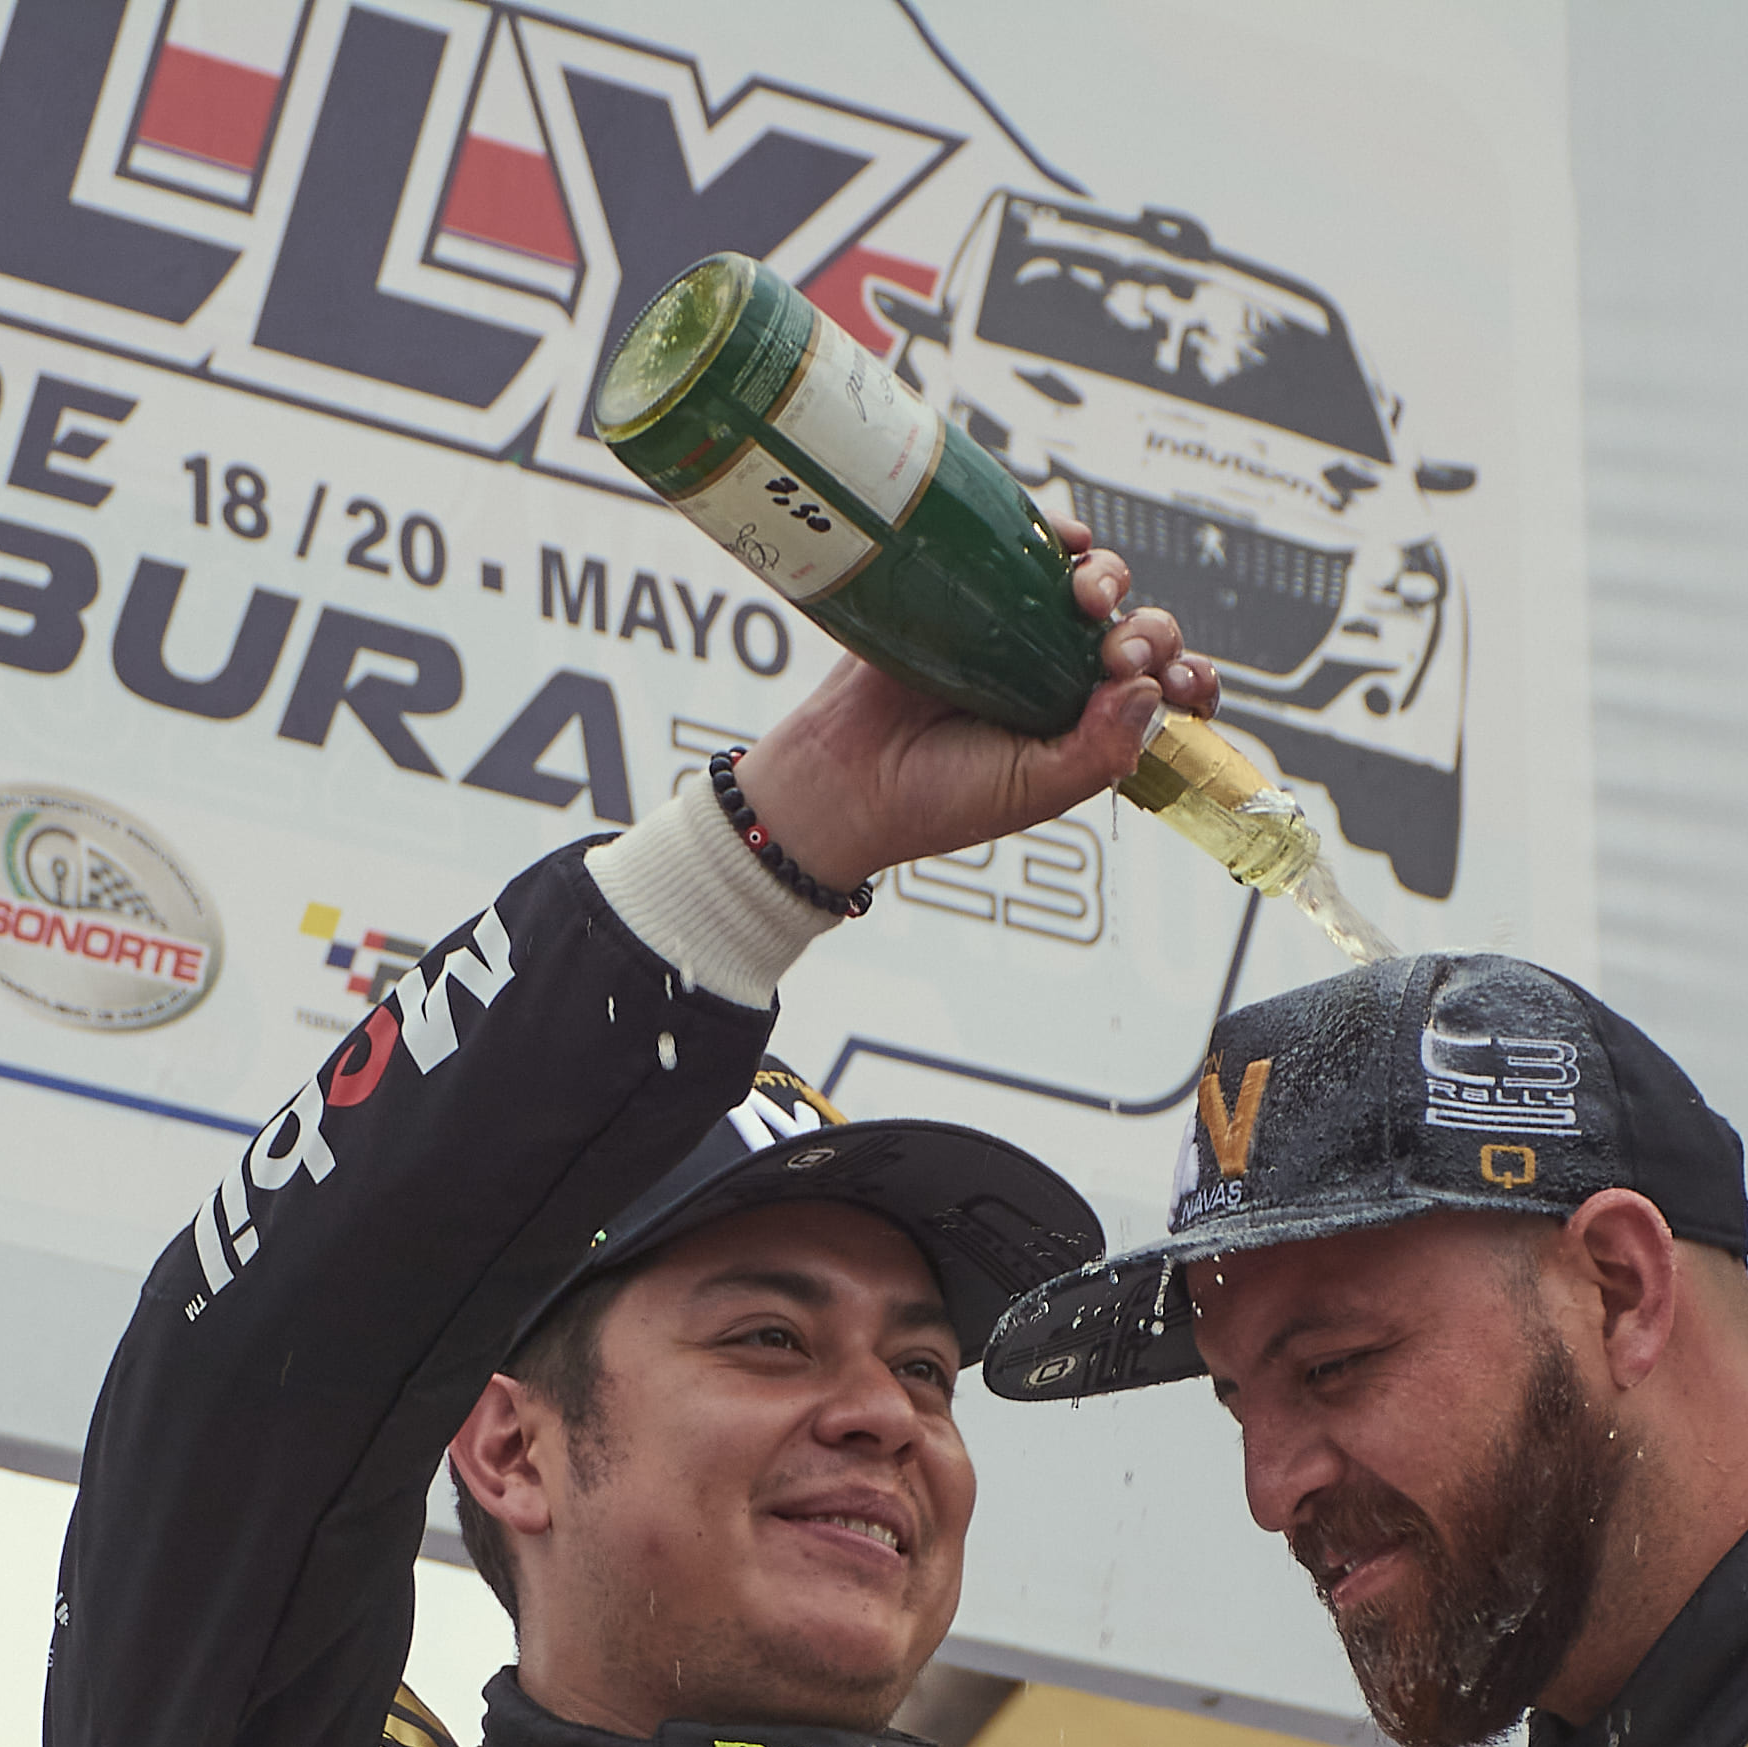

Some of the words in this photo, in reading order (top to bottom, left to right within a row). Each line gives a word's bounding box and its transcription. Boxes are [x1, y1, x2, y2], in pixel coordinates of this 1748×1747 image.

[539, 545, 791, 677] MAYO
[194, 903, 515, 1295] Mobil
[1181, 1179, 1243, 1225] NAVAS
